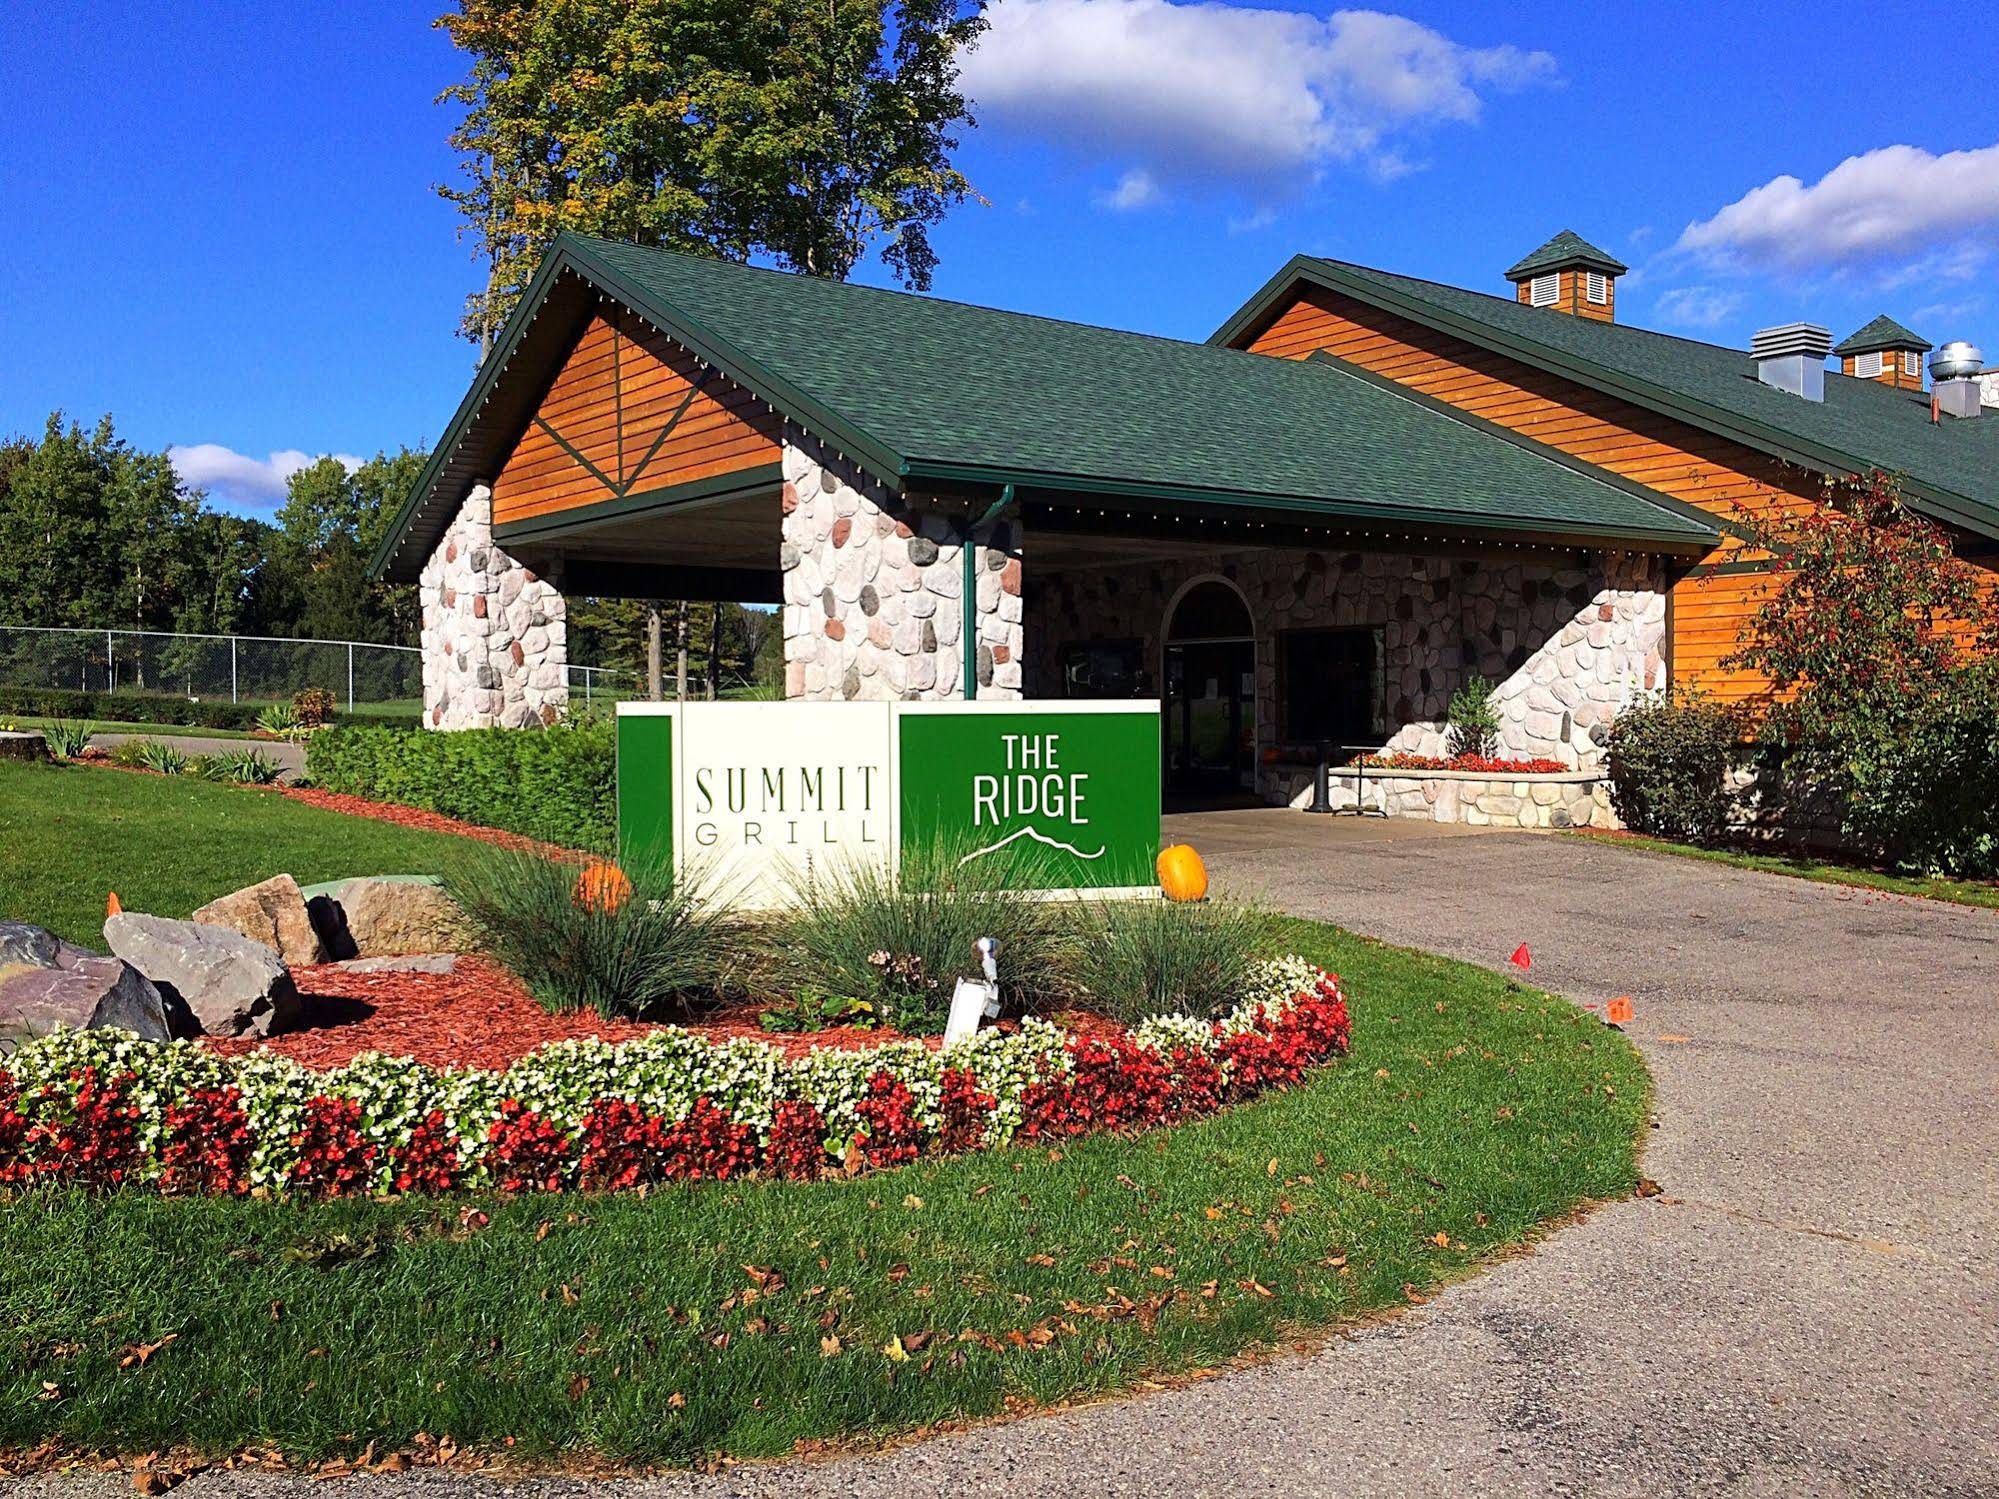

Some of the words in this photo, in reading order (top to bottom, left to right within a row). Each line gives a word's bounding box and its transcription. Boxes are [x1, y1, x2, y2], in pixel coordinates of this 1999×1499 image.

[1001, 734, 1060, 770] THE
[696, 766, 877, 814] SUMMIT
[974, 774, 1089, 826] RIDGE
[695, 821, 876, 847] GRILL
